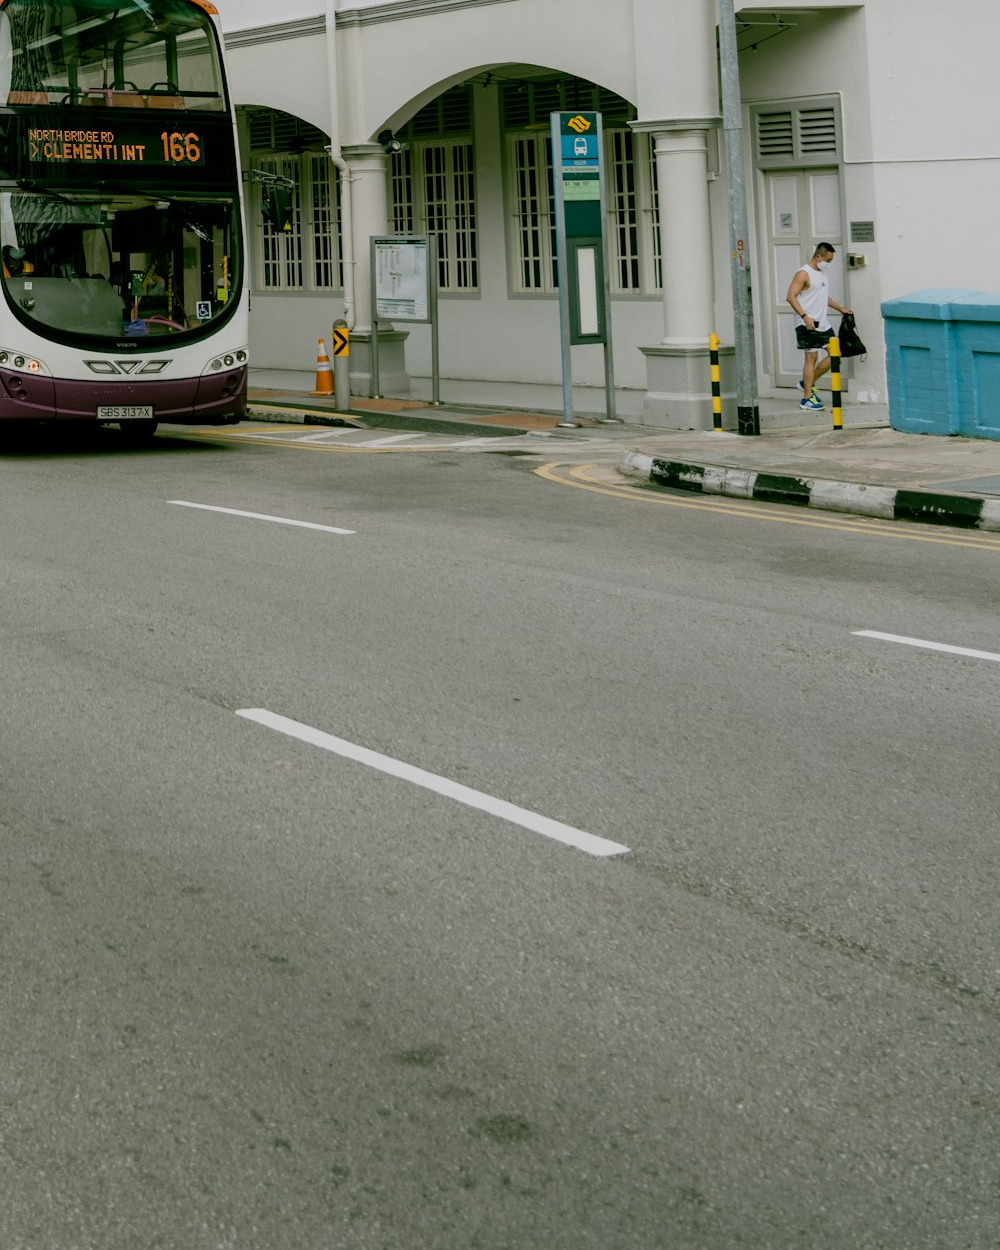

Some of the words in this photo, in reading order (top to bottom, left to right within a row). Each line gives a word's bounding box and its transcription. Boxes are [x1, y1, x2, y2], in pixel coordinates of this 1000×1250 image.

[29, 129, 63, 141] NORTH
[64, 130, 100, 143] BRIDGE
[100, 131, 115, 143] RD
[43, 143, 118, 160] CLEMENTI
[122, 145, 146, 161] INT
[160, 131, 201, 162] 166
